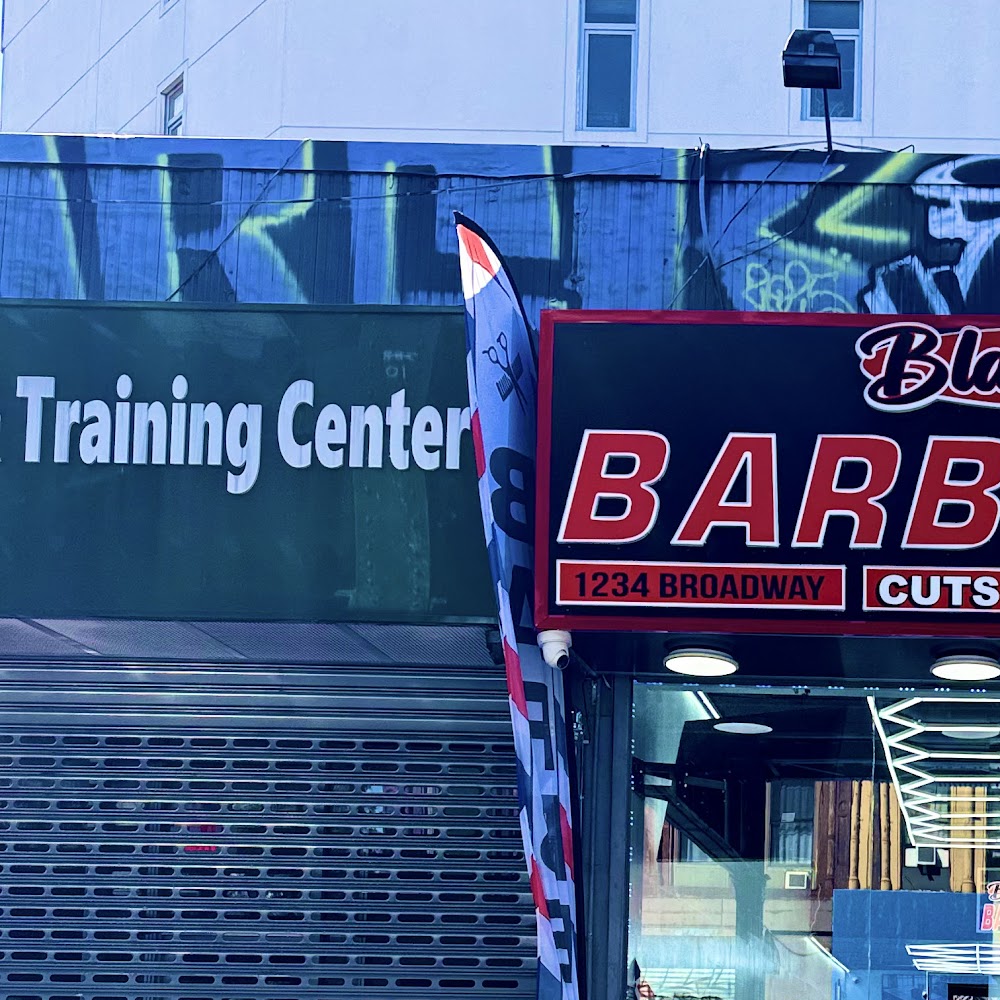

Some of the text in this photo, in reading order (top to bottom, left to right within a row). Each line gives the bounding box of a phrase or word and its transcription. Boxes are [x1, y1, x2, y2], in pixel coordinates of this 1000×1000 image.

[16, 374, 471, 494] Training Center
[575, 572, 826, 601] 1234 BROADWAY
[878, 574, 1000, 608] CUTS
